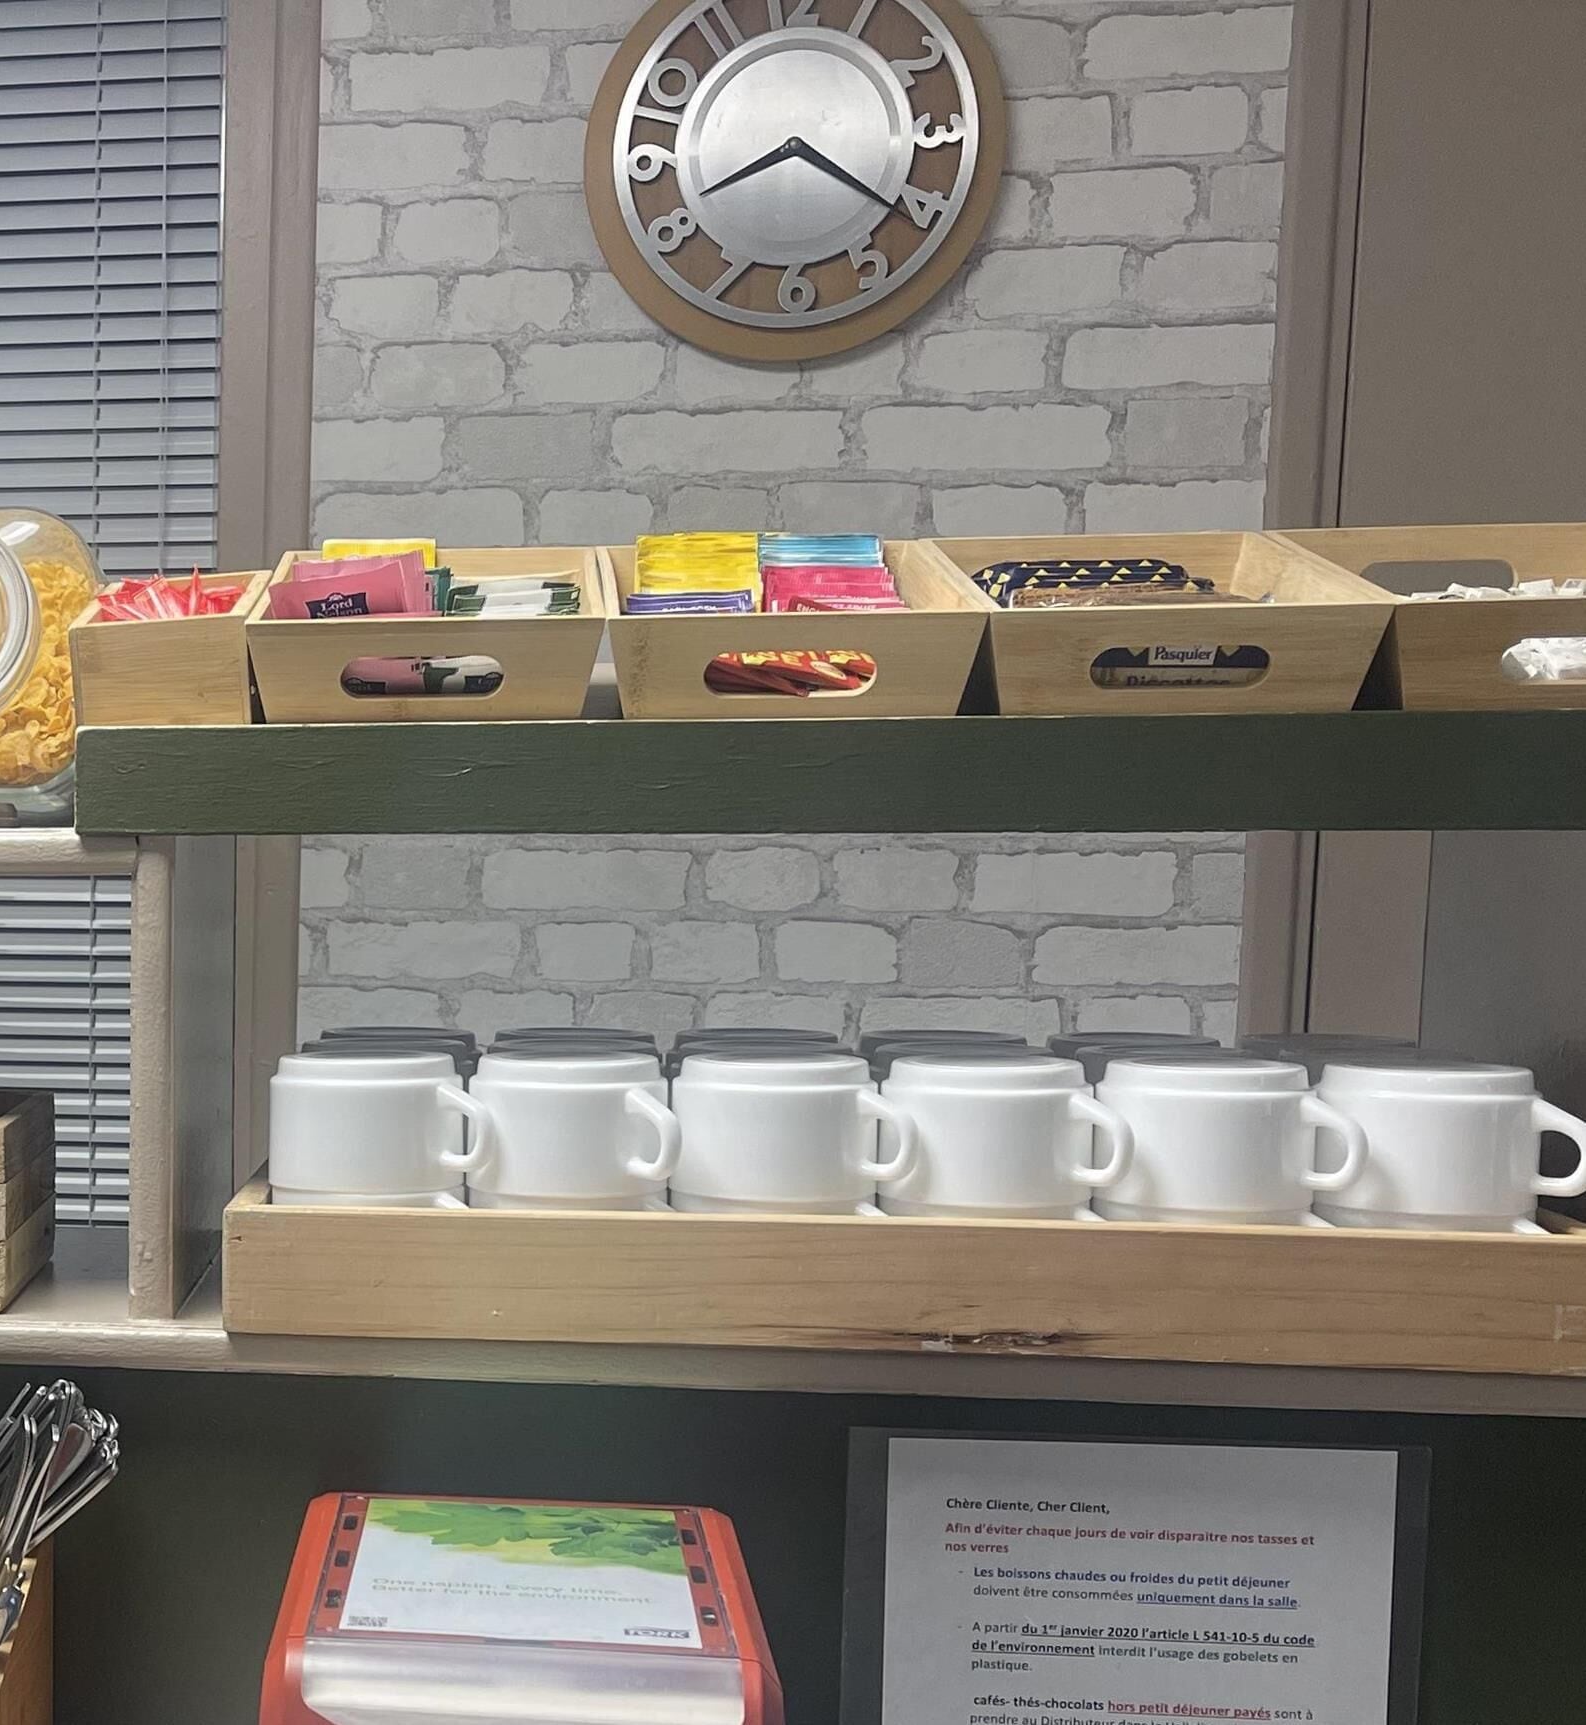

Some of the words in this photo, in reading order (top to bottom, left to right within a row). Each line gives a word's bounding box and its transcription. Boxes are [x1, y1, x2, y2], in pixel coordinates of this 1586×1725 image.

[890, 35, 944, 90] 2
[632, 58, 699, 125] 10
[913, 112, 965, 150] 3
[627, 143, 677, 182] 9
[901, 183, 952, 229] 4
[647, 208, 698, 254] 8
[848, 232, 889, 291] 5
[705, 246, 754, 302] 7
[777, 264, 816, 314] 6
[320, 599, 354, 612] Lord
[946, 1498, 982, 1510] Chère
[986, 1499, 1034, 1512] Cliente,
[1037, 1500, 1066, 1512] Cher
[1069, 1502, 1110, 1515] Client,
[945, 1523, 971, 1534] Afin
[974, 1524, 1023, 1535] d'éviter
[1026, 1525, 1072, 1539] chaque
[1074, 1527, 1107, 1539] jours
[1110, 1528, 1127, 1539] de
[1130, 1529, 1154, 1540] voir
[1230, 1534, 1255, 1543] nos
[1258, 1534, 1298, 1545] tasses
[1300, 1535, 1315, 1545] et
[945, 1543, 967, 1552] nos
[970, 1544, 1009, 1553] verres
[974, 1567, 994, 1578] Les
[997, 1567, 1051, 1580] boissons
[1055, 1569, 1107, 1582] chaudes
[1110, 1573, 1126, 1582] ou
[1130, 1572, 1174, 1585] froides
[1177, 1574, 1194, 1585] du
[1197, 1575, 1229, 1587] petit
[1232, 1576, 1291, 1590] déjeuner
[973, 1585, 1020, 1597] doivent
[1023, 1587, 1048, 1598] être
[1052, 1589, 1133, 1601] consommées
[1137, 1592, 1215, 1605] uniquement
[1219, 1594, 1249, 1606] dans
[1253, 1595, 1264, 1606] la
[625, 1627, 689, 1639] TORK
[972, 1622, 981, 1631] A
[984, 1622, 1018, 1636] partir
[1021, 1623, 1038, 1634] du
[1060, 1625, 1104, 1638] janvier
[1107, 1627, 1138, 1638] 2020
[1142, 1628, 1189, 1641] l'article
[1193, 1631, 1200, 1641] L
[1203, 1631, 1260, 1643] 541-10-5
[1263, 1633, 1280, 1645] du
[1283, 1634, 1315, 1645] code
[972, 1640, 987, 1651] de
[991, 1640, 1095, 1655] l'environnement
[1099, 1645, 1146, 1657] interdit
[1149, 1647, 1194, 1661] l'usage
[1197, 1649, 1220, 1661] des
[1223, 1650, 1279, 1663] gobelets
[1282, 1654, 1298, 1663] en
[971, 1659, 1032, 1672] plastique.
[970, 1714, 1019, 1725] prendre
[1022, 1717, 1037, 1725] au
[1014, 1696, 1104, 1710] thés-chocolats
[1107, 1700, 1135, 1712] hors
[1139, 1703, 1169, 1715] petit
[1172, 1704, 1231, 1718] déjeuner
[1234, 1707, 1271, 1720] payés
[1274, 1710, 1302, 1720] sont
[1305, 1709, 1314, 1720] à
